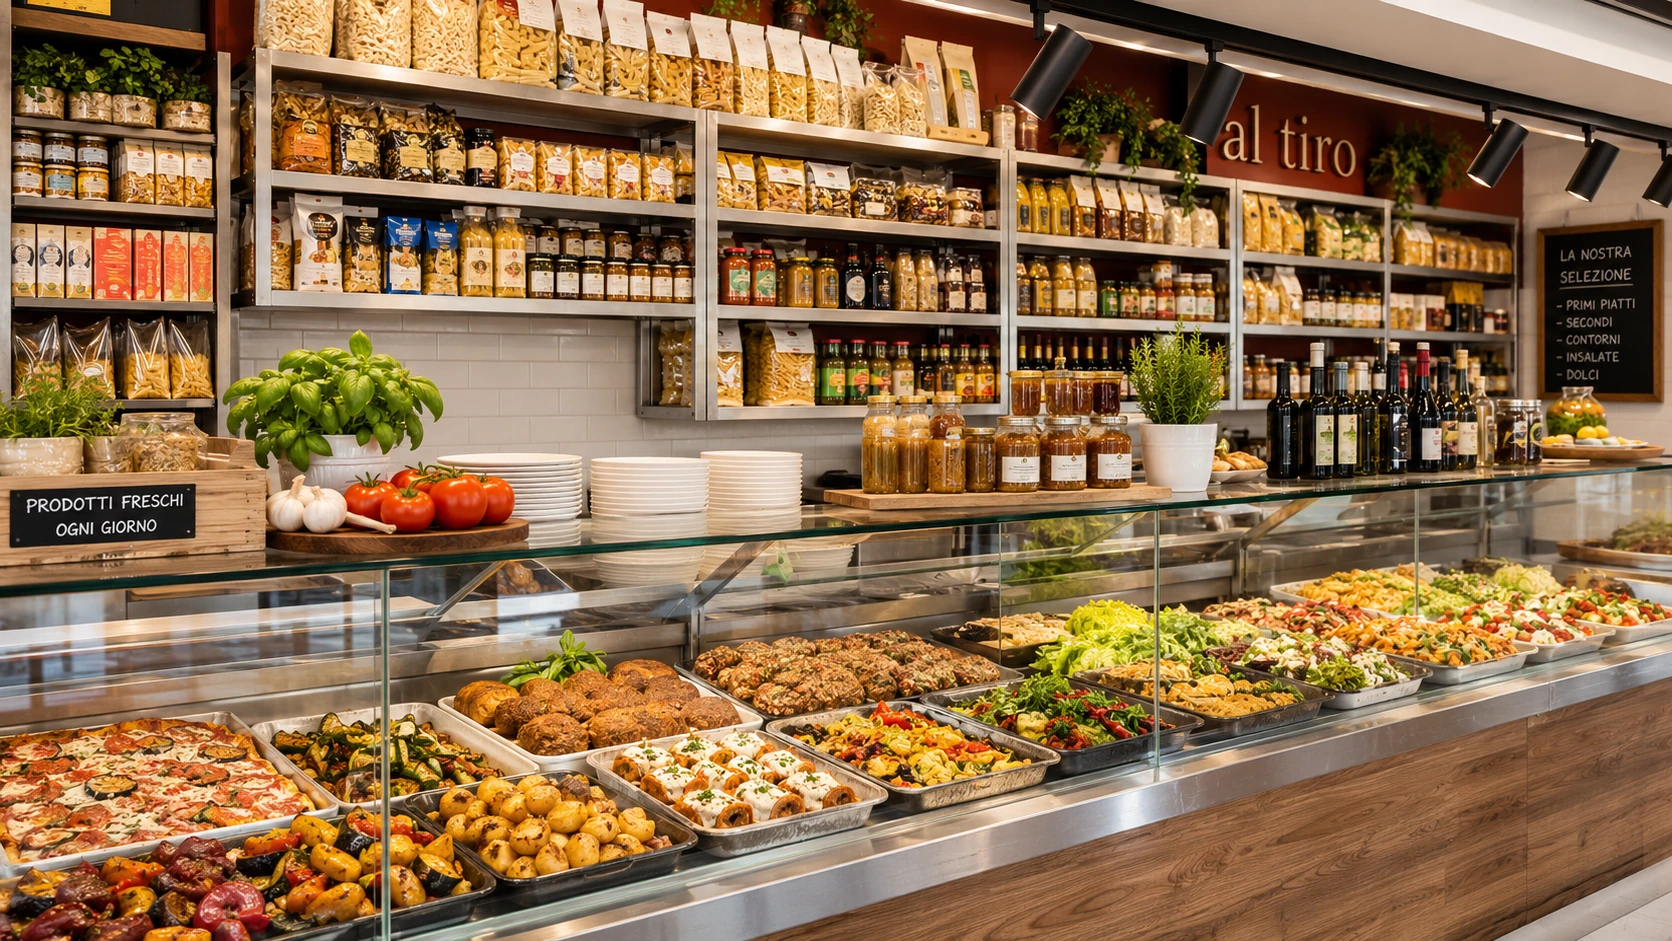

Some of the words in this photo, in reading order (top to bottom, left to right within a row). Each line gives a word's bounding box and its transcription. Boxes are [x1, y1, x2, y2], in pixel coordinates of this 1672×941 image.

[1223, 104, 1263, 164] al
[1280, 116, 1356, 177] tiro
[1560, 249, 1576, 262] LA
[1580, 246, 1632, 260] NOSTRA
[1560, 268, 1632, 284] SELEZIONE
[1566, 299, 1595, 311] PRIMI
[1600, 298, 1636, 310] PIATTI
[1566, 316, 1613, 328] SECONDI
[1566, 334, 1620, 345] CONTORNI
[1566, 351, 1620, 362] INSALATE
[1566, 369, 1599, 380] DOLCI
[26, 496, 113, 514] PRODOTTI
[121, 493, 184, 510] FRESCHI
[55, 521, 94, 537] OGNI
[100, 518, 157, 535] GIORNO
